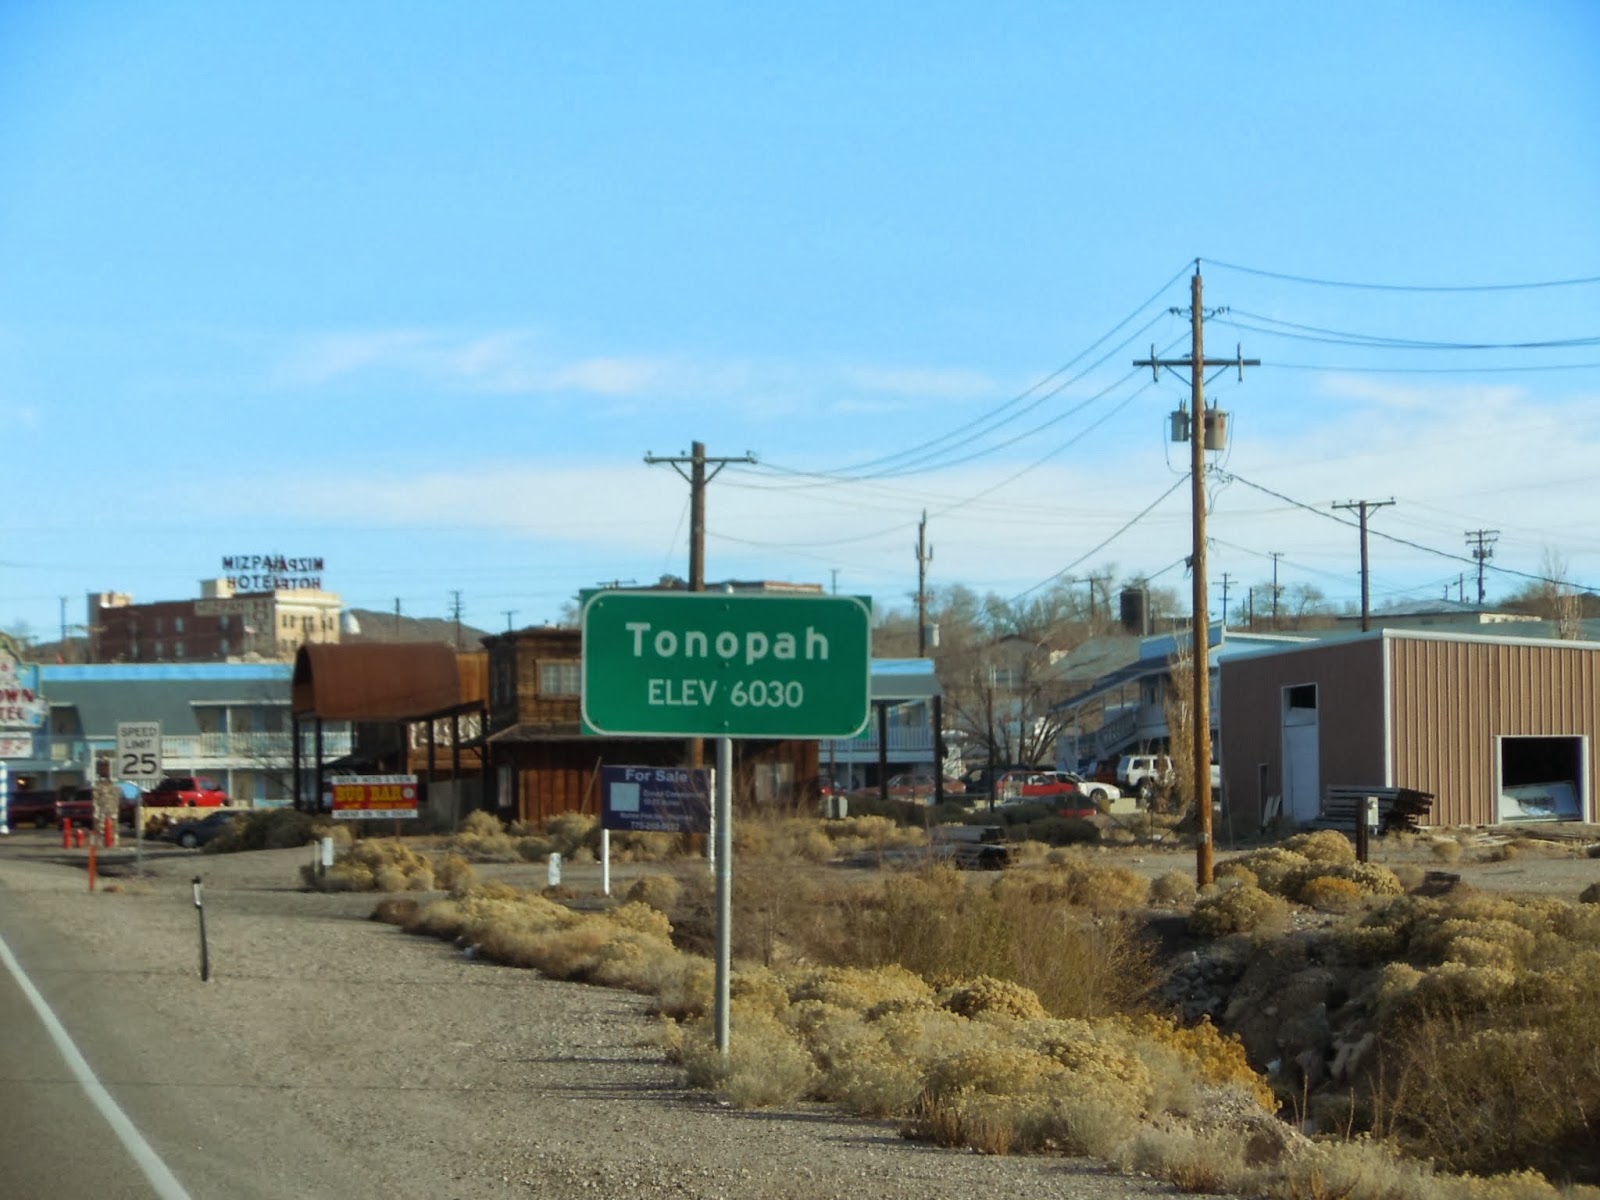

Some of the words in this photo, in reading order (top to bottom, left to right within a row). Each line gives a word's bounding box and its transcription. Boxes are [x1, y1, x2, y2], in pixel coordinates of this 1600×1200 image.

[625, 622, 829, 665] Tonopah
[648, 679, 717, 706] ELEV
[730, 680, 804, 707] 6030
[121, 727, 157, 737] SPEED
[125, 739, 153, 749] LIMIT
[122, 753, 157, 775] 25
[625, 769, 651, 781] For
[655, 770, 688, 782] Sale
